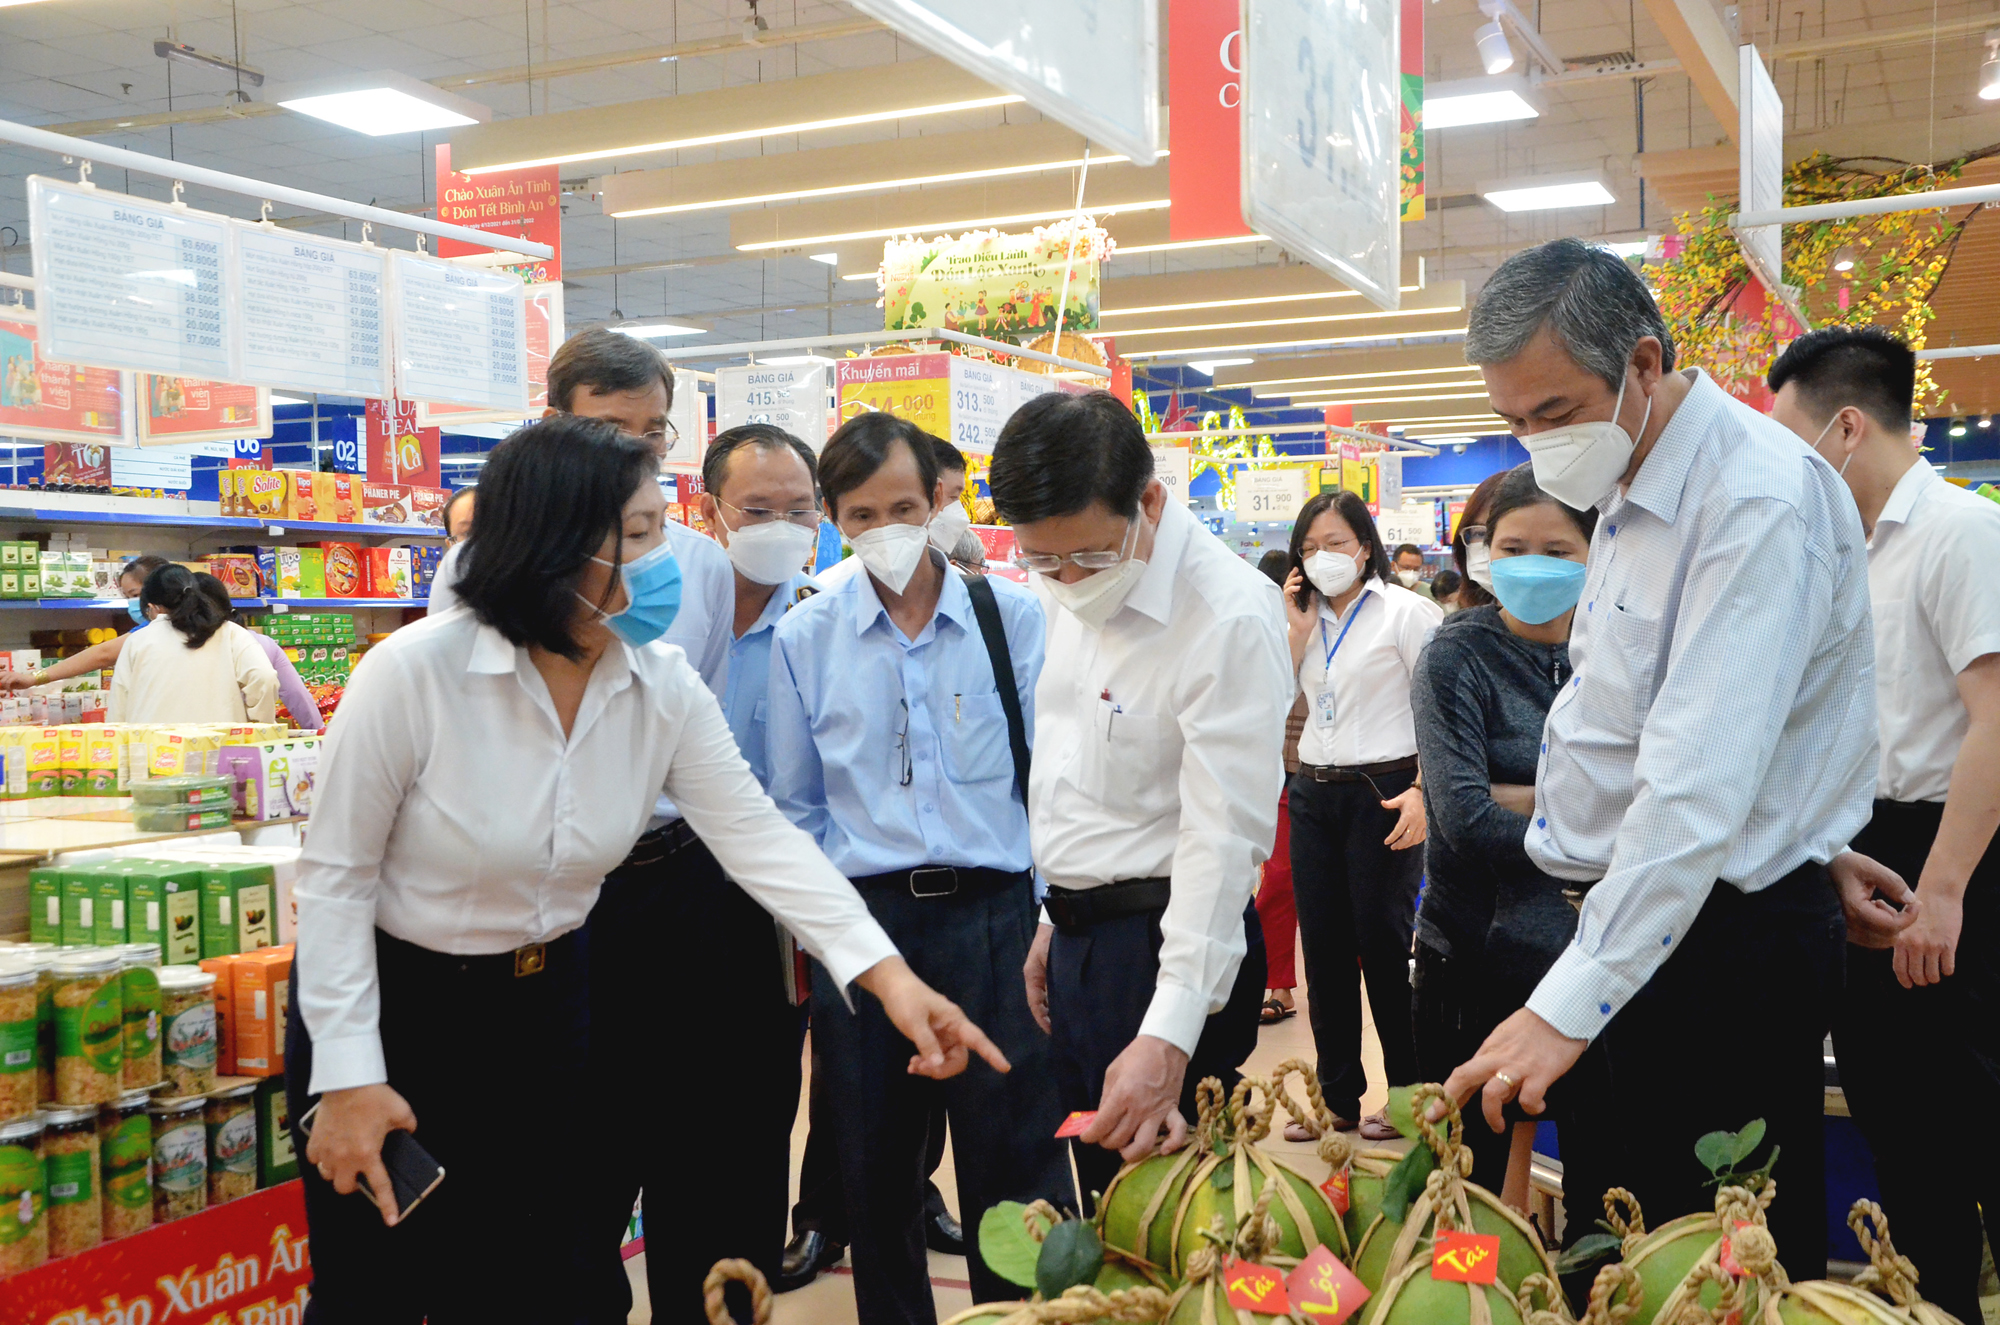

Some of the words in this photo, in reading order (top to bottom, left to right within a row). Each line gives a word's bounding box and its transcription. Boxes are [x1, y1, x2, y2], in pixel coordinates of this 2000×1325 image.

[445, 188, 474, 203] Chào
[476, 184, 505, 200] Xuân
[507, 180, 523, 196] Ân
[453, 205, 477, 220] Đón
[478, 201, 498, 217] Tết
[527, 200, 544, 213] An
[146, 216, 165, 230] GIÁ
[182, 239, 217, 254] 63.600đ
[182, 252, 218, 268] 33.800đ
[320, 251, 335, 263] GIÁ
[946, 253, 972, 265] Trao
[349, 270, 377, 283] 63.600đ
[968, 264, 995, 282] Lộc
[998, 262, 1046, 278] Xanh
[185, 306, 220, 321] 47.500đ
[350, 331, 379, 344] 47.500đ
[748, 371, 775, 384] BẢNG
[778, 370, 795, 383] GIÁ
[841, 363, 892, 383] Khuyến
[895, 362, 919, 377] mãi
[964, 368, 982, 381] BẢNG
[982, 373, 993, 383] GIÁ
[49, 385, 71, 399] viên
[190, 389, 210, 401] viên
[957, 390, 982, 412] 313.
[983, 395, 994, 406] 500
[776, 413, 790, 421] 500
[958, 422, 984, 444] 242.
[985, 427, 996, 438] 500
[336, 440, 356, 462] 02
[253, 475, 281, 495] Solite
[363, 487, 389, 500] PHANER
[390, 489, 400, 500] PIE
[434, 492, 444, 503] PIE
[1276, 493, 1291, 502] 900
[1408, 527, 1422, 535] 500
[278, 553, 301, 567] Tipo
[334, 551, 354, 567] Daisy
[1437, 1245, 1489, 1274] Tài
[156, 1252, 259, 1323] Xuân
[1230, 1274, 1276, 1303] Tài
